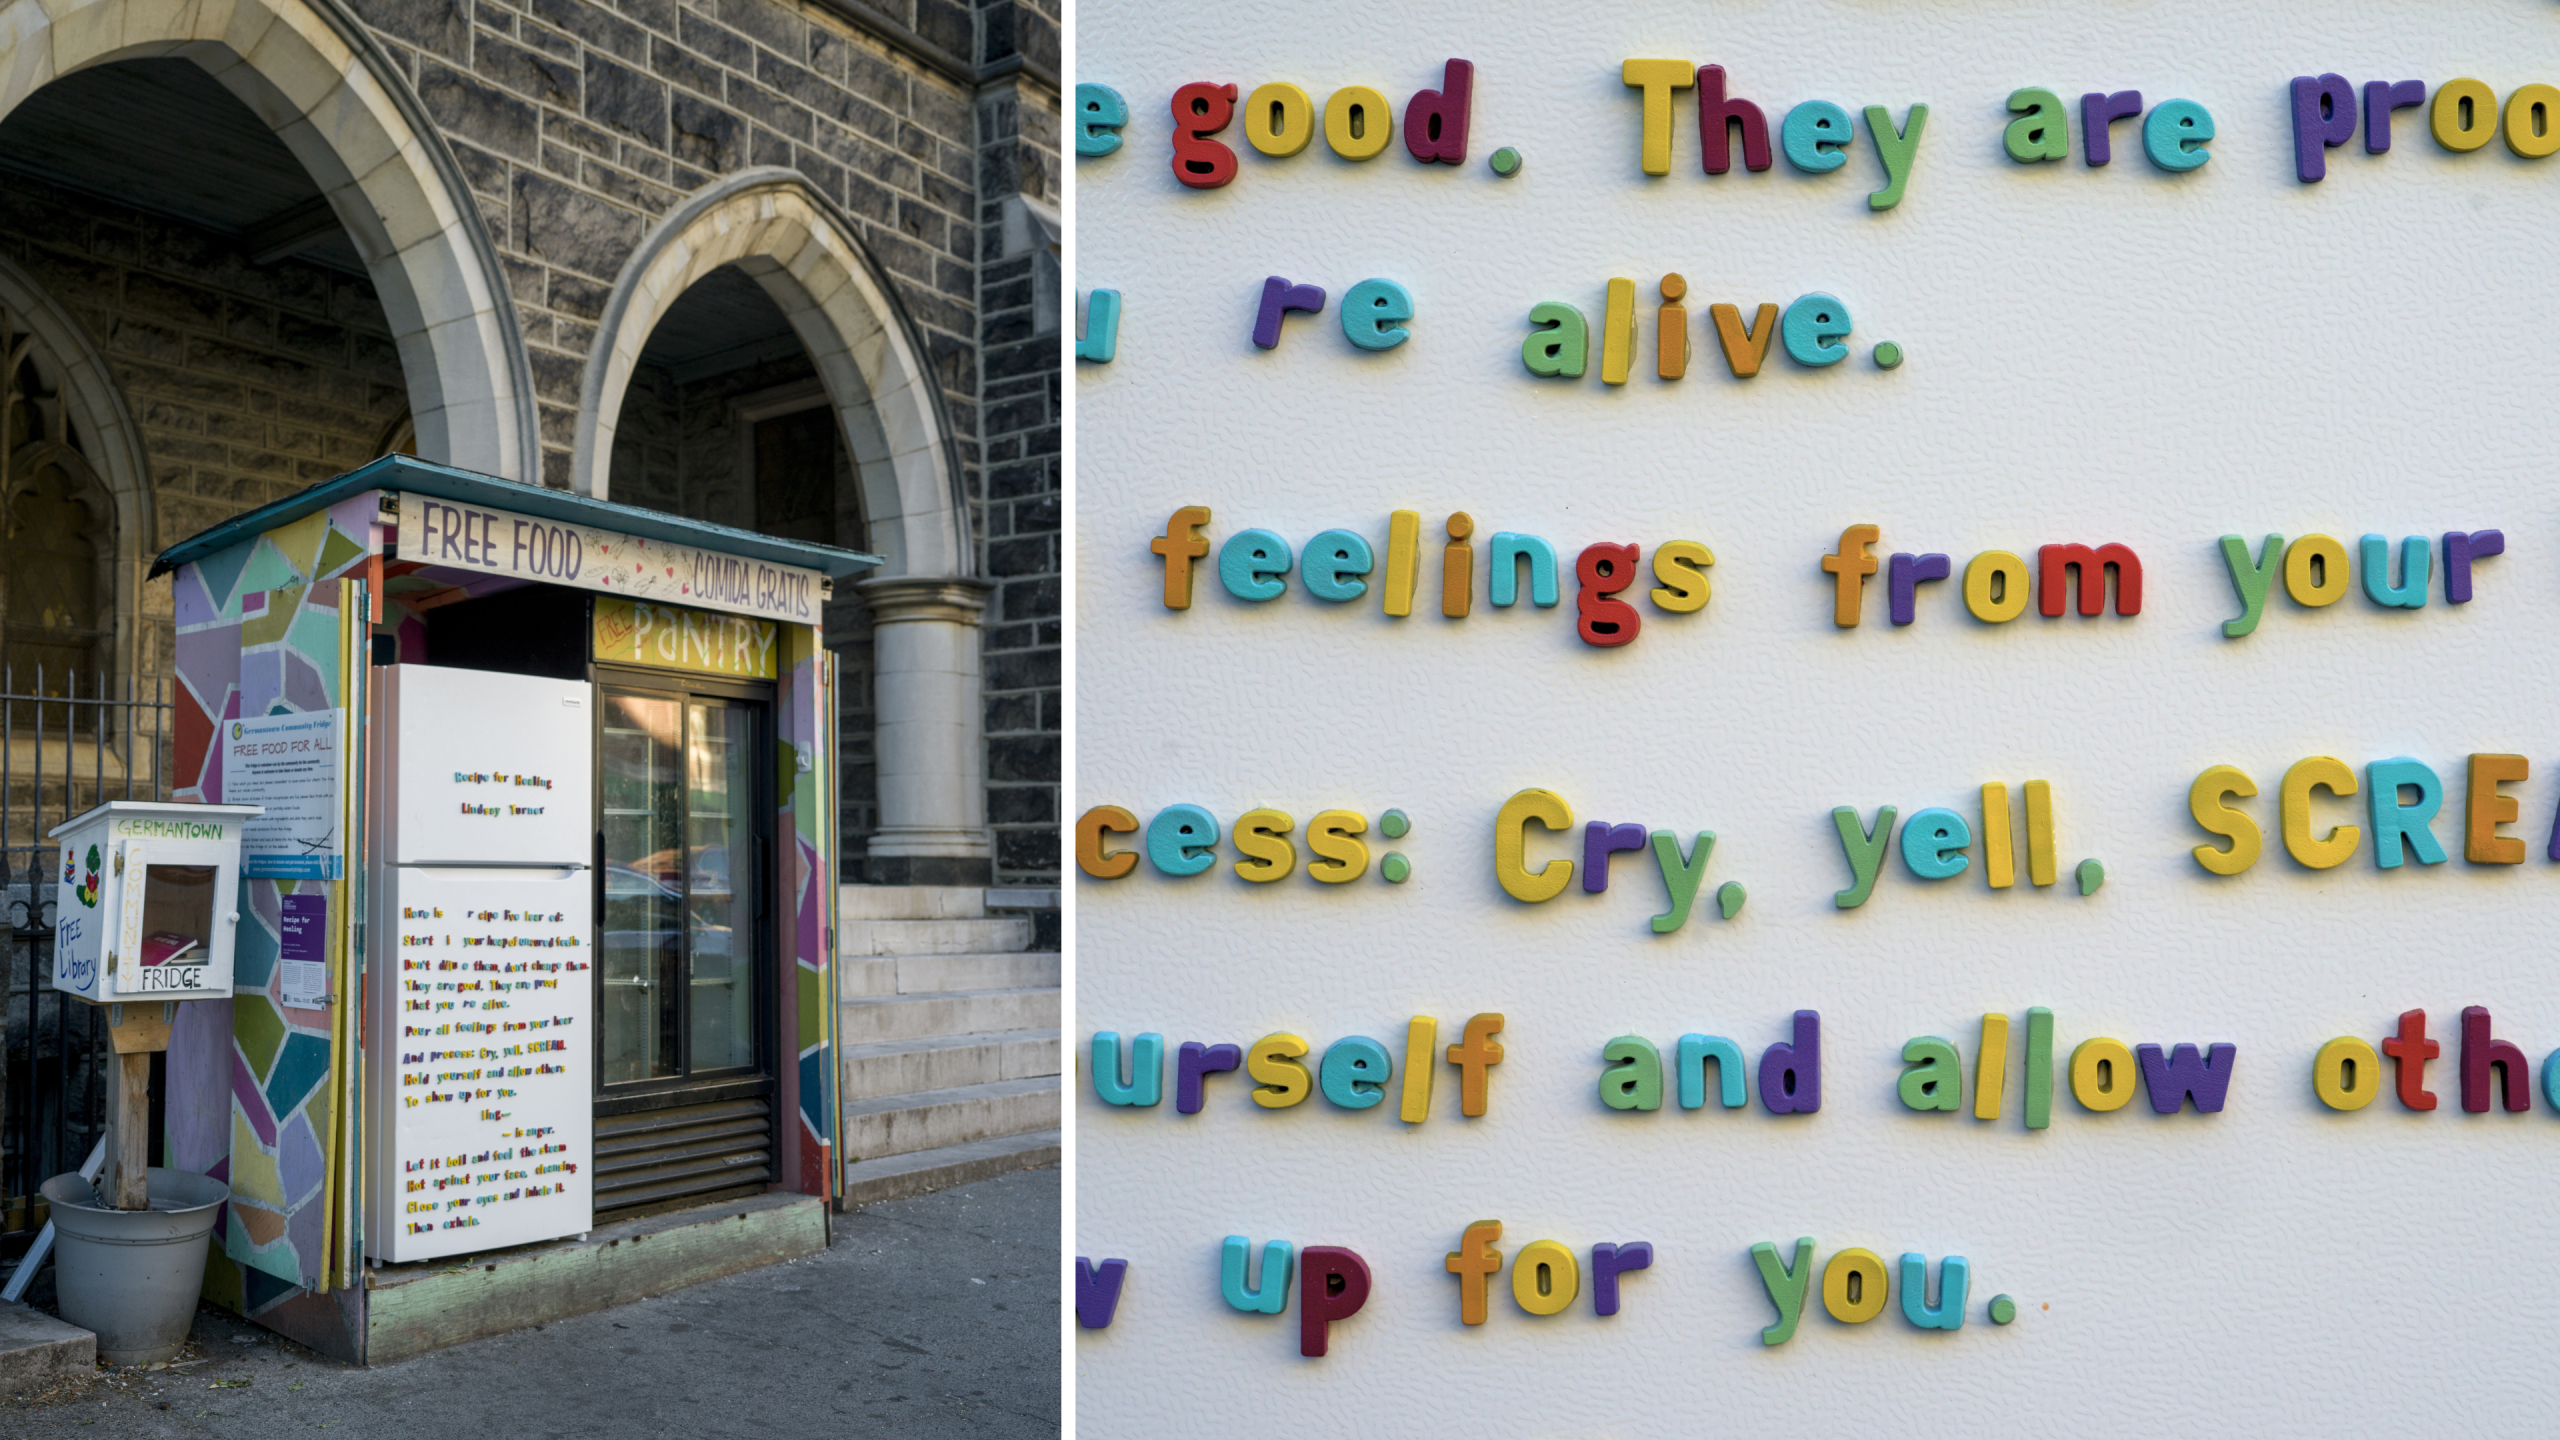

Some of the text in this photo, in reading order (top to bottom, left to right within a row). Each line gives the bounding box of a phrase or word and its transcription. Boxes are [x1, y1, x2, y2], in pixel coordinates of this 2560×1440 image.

[1171, 58, 1522, 189] good.
[1622, 58, 1928, 211] They
[2003, 86, 2215, 172] are
[2290, 72, 2560, 183] proo
[1522, 272, 1904, 386] alive.
[421, 501, 810, 618] FREE FOOD COMIDA GRATIS
[1150, 505, 2505, 648] feelings from your
[596, 604, 632, 645] FREE
[244, 720, 331, 735] Germantown Community Fridge
[234, 737, 332, 756] FREE FOOD FOR ALL
[455, 772, 552, 790] Recipe for Healing
[461, 803, 544, 817] Lindsay Turner
[118, 820, 223, 840] GERMANTOWN
[1075, 752, 2560, 934] cess: Cry, yell, SCRE
[122, 848, 142, 992] COMMUNITY
[283, 916, 299, 924] Recipe
[404, 907, 430, 919] Here
[434, 907, 443, 918] is
[283, 926, 302, 934] Healing
[403, 935, 434, 946] Start
[463, 937, 485, 947] your
[487, 935, 507, 949] heap
[508, 936, 518, 947] of
[519, 936, 554, 948] uncured
[404, 959, 430, 971] Don't
[504, 962, 527, 973] don't
[531, 960, 561, 973] change
[143, 968, 201, 990] FRIDGE
[405, 979, 558, 994] They are good. They are proof
[406, 999, 430, 1012] That
[436, 1001, 454, 1013] you
[482, 999, 510, 1010] alive.
[405, 1016, 573, 1037] Pour all feelings from your hear
[403, 1052, 424, 1064] And
[430, 1050, 475, 1062] process:
[480, 1047, 499, 1061] Cry,
[528, 1040, 567, 1053] SCREAM.
[404, 1063, 565, 1086] Hold yourself and allow others
[1598, 1009, 1822, 1115] and
[1897, 1005, 2237, 1130] allow
[2312, 1004, 2560, 1114] oth
[405, 1088, 517, 1108] To show up for you.
[515, 1127, 524, 1138] is
[526, 1127, 555, 1139] anger.
[406, 1144, 566, 1173] Let it boil and feel the steam
[407, 1179, 425, 1193] Hot
[433, 1173, 470, 1190] against
[477, 1173, 500, 1185] your
[407, 1183, 565, 1214] Close your eyes and inhale it.
[407, 1215, 480, 1235] Then exhale.
[1220, 1234, 1372, 1357] up
[1445, 1219, 1654, 1326] for
[1750, 1236, 2018, 1346] you.
